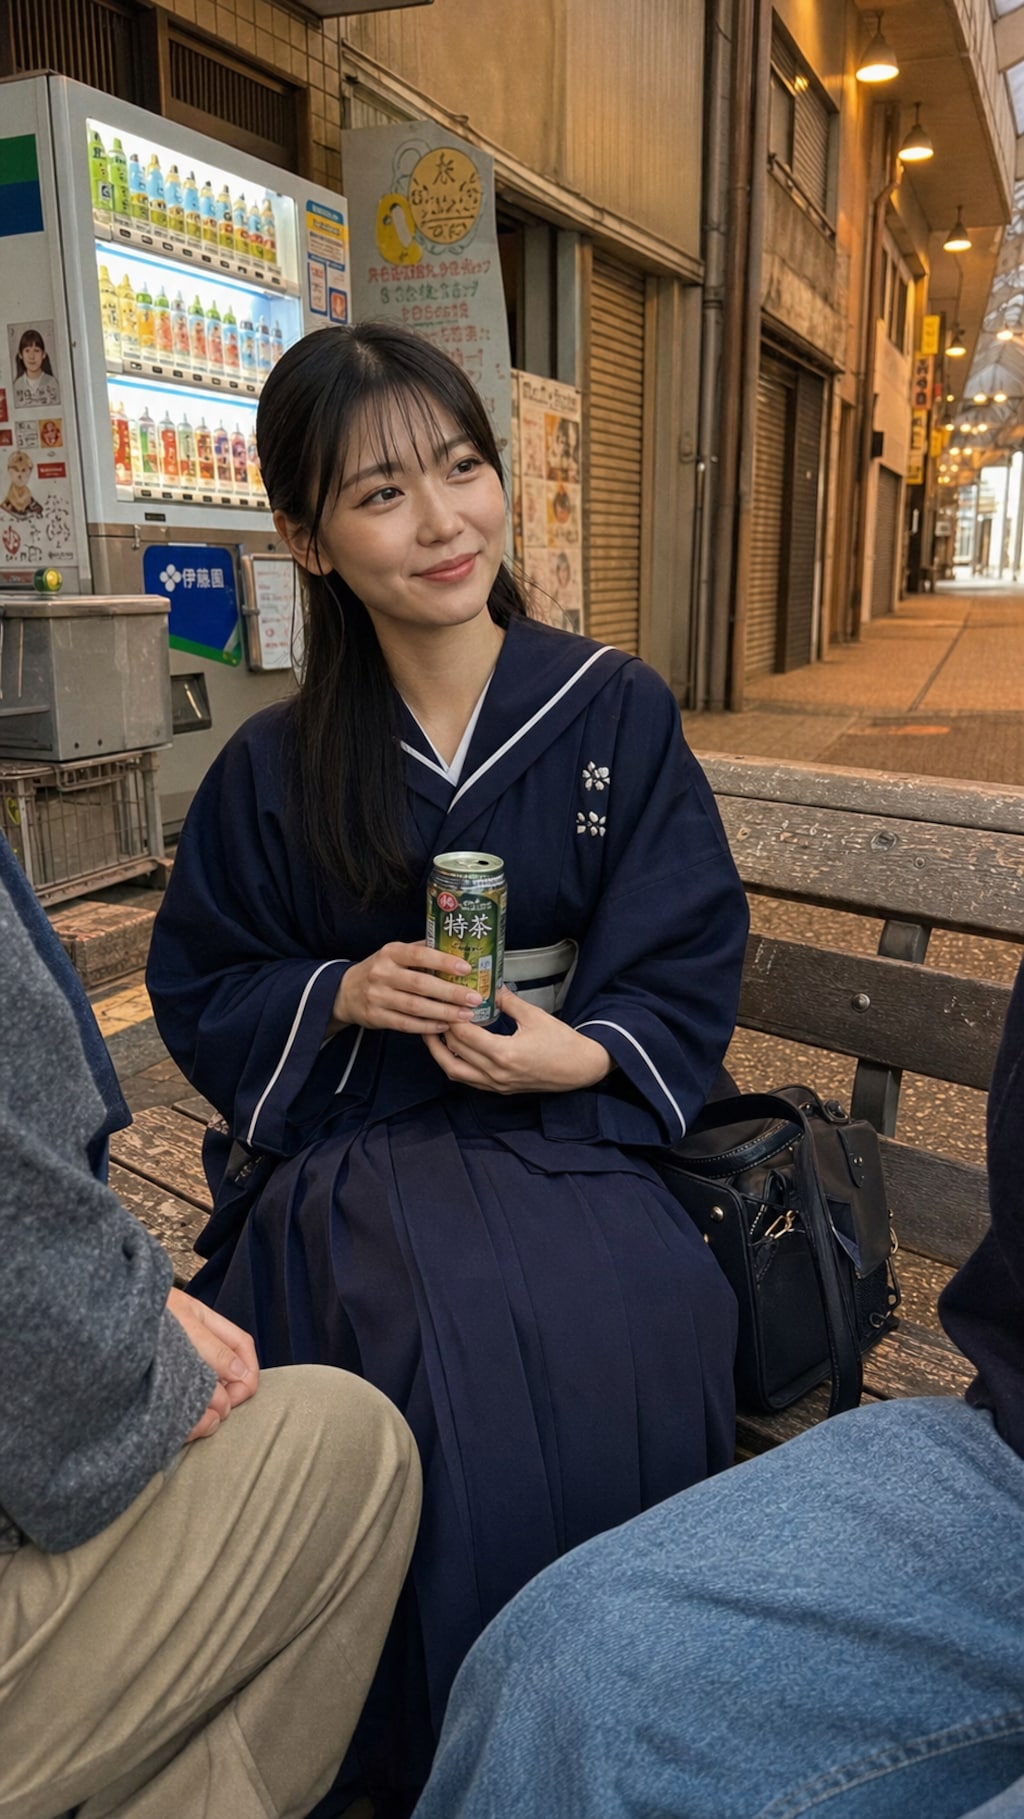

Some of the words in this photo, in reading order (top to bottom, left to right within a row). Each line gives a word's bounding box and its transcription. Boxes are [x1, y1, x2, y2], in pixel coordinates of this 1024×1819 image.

[182, 568, 224, 589] 伊藤園
[443, 913, 493, 940] 特茶
